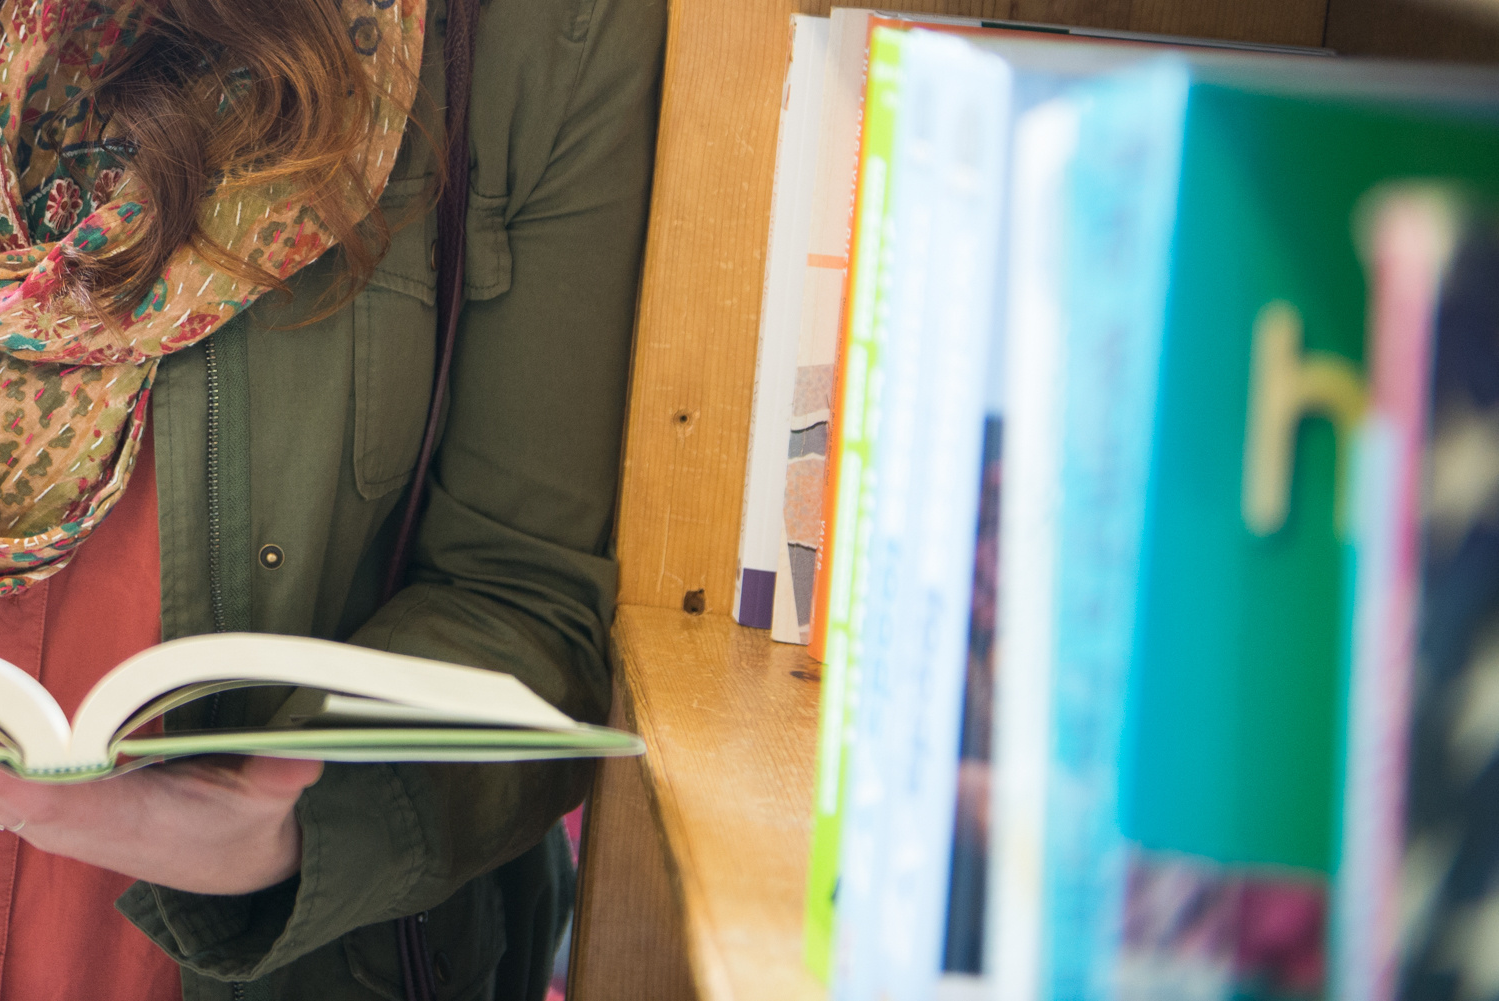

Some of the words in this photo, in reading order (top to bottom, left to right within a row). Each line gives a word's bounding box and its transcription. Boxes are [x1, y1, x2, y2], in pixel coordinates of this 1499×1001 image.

[861, 45, 870, 86] THE
[847, 95, 865, 217] LONGEVITY
[841, 227, 852, 277] DIET
[815, 519, 827, 571] VALTER
